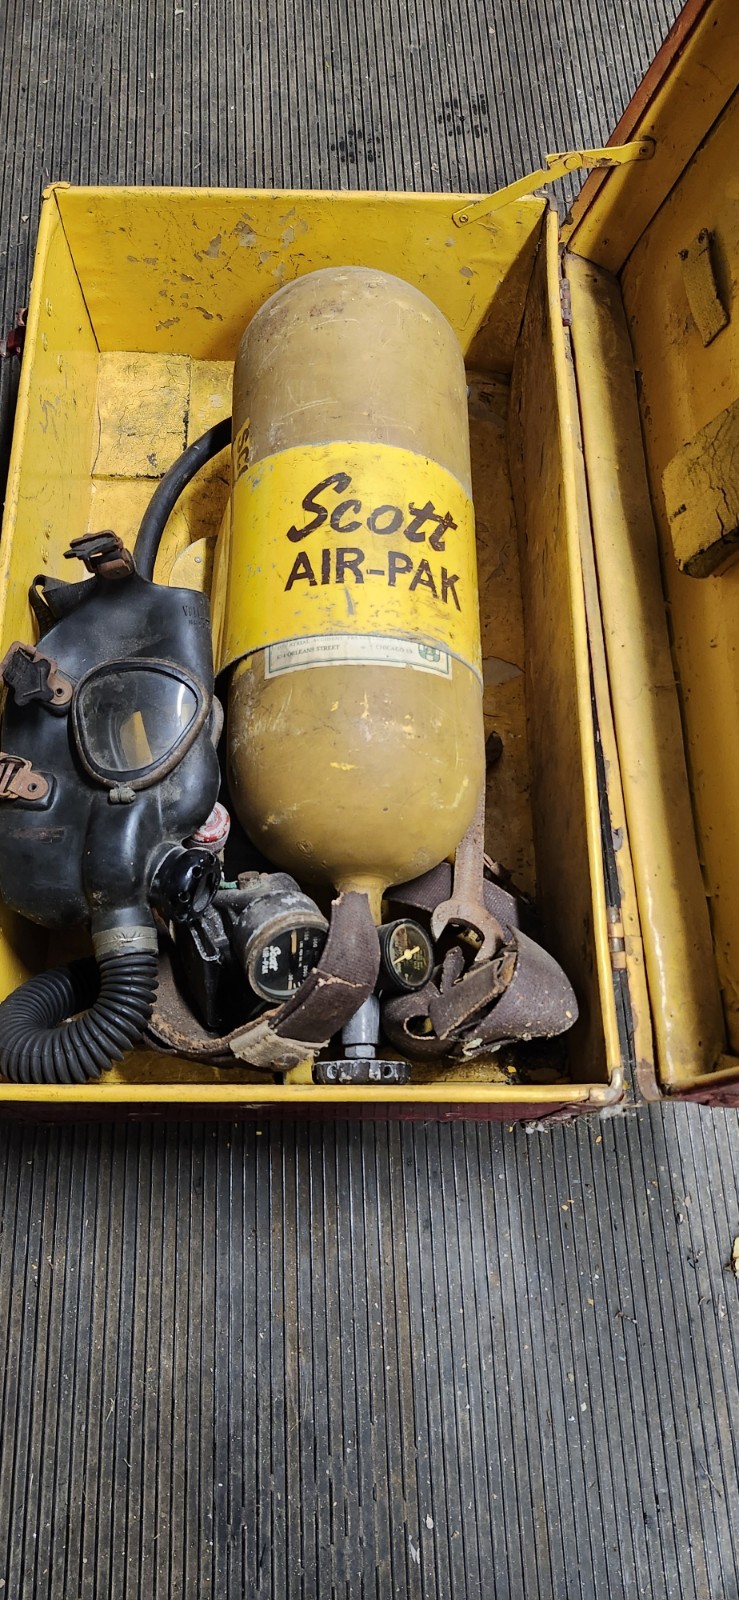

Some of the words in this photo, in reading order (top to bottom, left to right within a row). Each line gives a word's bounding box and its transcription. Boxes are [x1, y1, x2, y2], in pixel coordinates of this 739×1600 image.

[286, 472, 458, 551] Scott
[284, 548, 462, 612] AIR-PAK
[287, 647, 315, 657] ORLEANS
[316, 644, 340, 652] STREET
